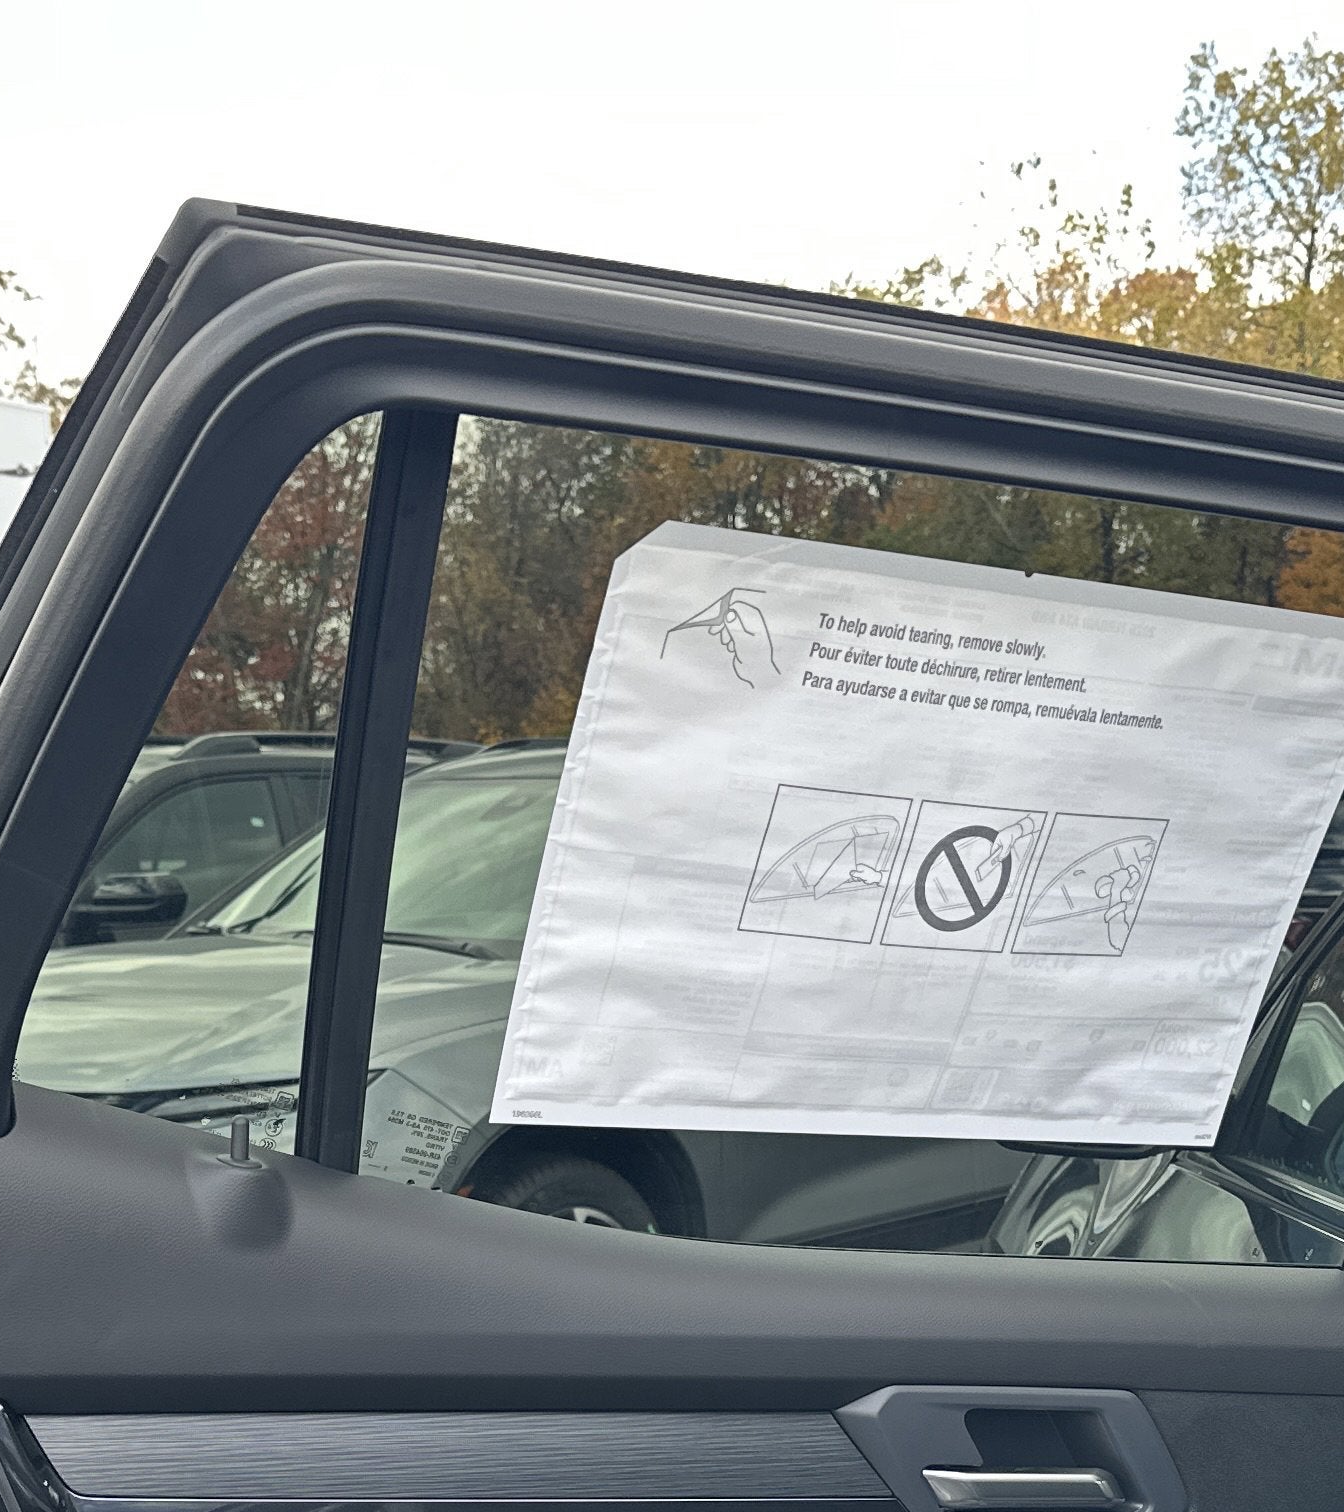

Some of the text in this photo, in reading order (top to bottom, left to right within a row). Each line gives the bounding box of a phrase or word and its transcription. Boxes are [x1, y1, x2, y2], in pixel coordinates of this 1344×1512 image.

[818, 612, 1046, 662] To help avoid tearing, remove slowly.
[808, 641, 1087, 694] Pour éviter toute déchirure, retirer lentement.
[801, 670, 1164, 730] Para ayudarse a evitar que se rompa, remuévala lentamente.
